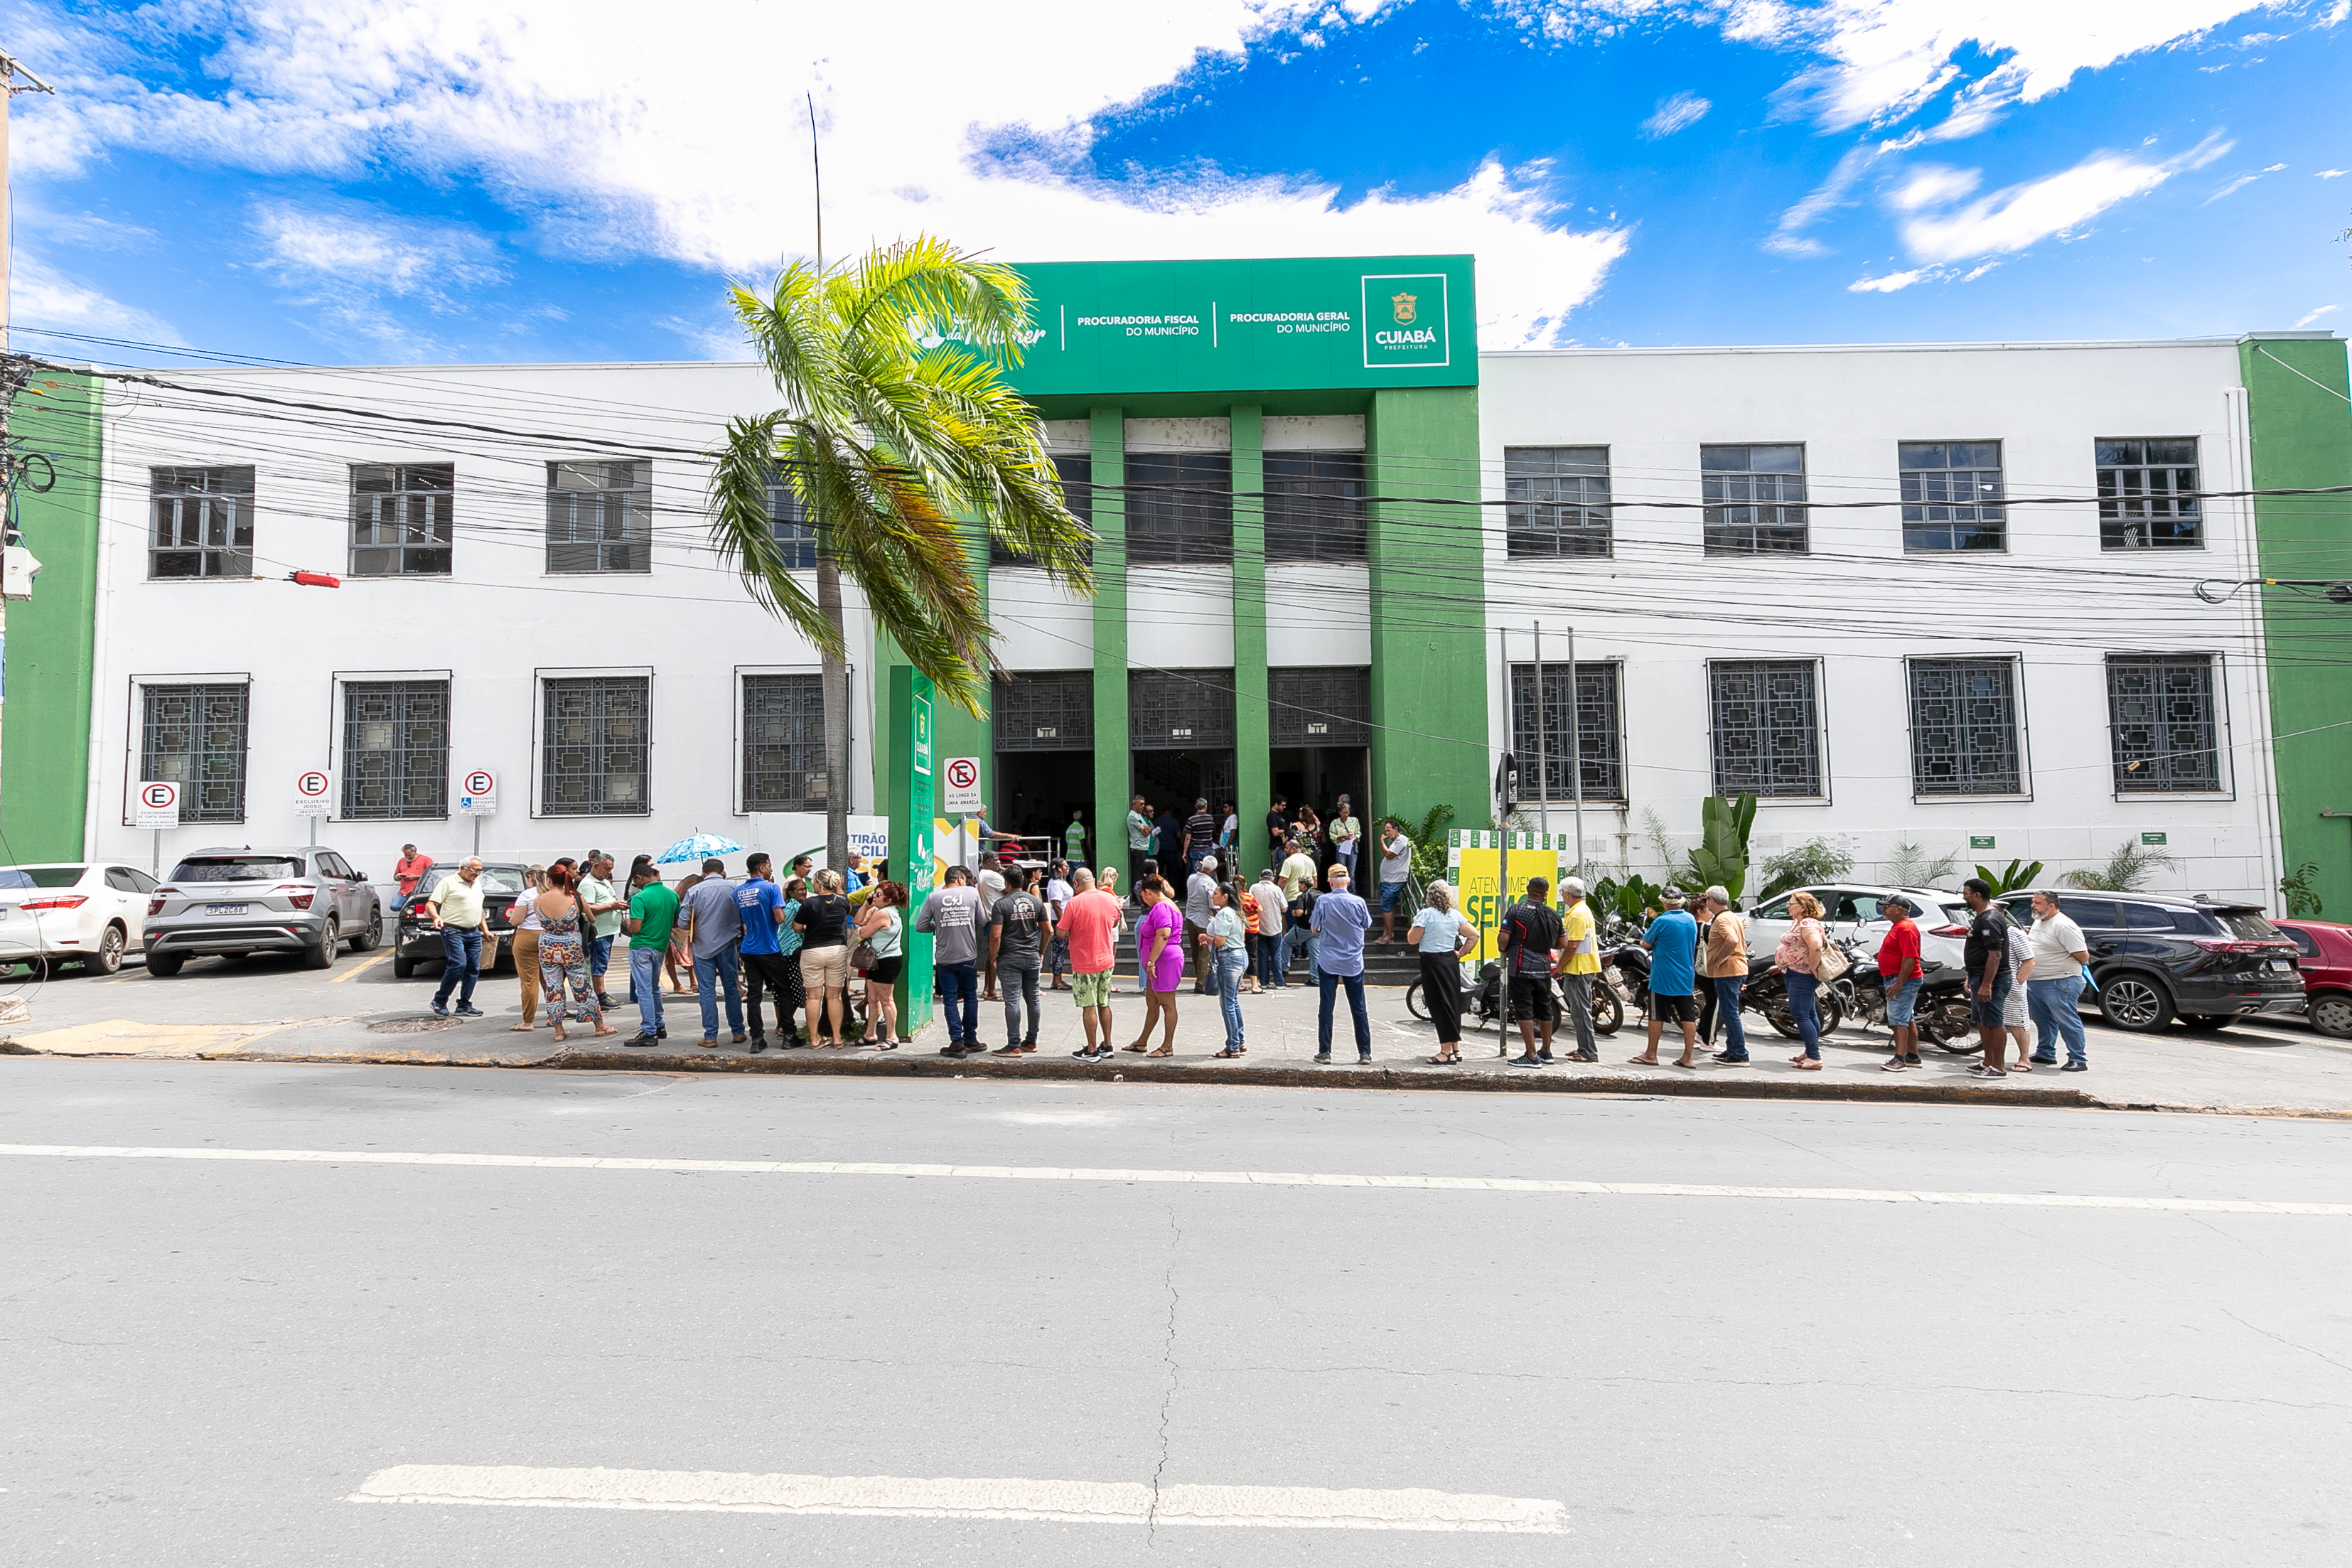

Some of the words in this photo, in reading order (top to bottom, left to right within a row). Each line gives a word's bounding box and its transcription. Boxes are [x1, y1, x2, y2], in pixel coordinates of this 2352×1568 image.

[1078, 316, 1162, 326] PROCURADORIA
[1164, 315, 1200, 325] FISCAL
[1230, 312, 1315, 323] PROCURADORIA
[1316, 311, 1350, 321] GERAL
[1126, 326, 1142, 336] DO
[1144, 325, 1200, 336] MUNICÍPIO
[1277, 323, 1294, 333] DO
[1296, 321, 1350, 333] MUNICÍPIO
[1375, 326, 1437, 345] CUIABÁ
[307, 776, 319, 791] E
[473, 775, 485, 790] E
[151, 788, 166, 804] E
[847, 832, 886, 844] TIRÃO
